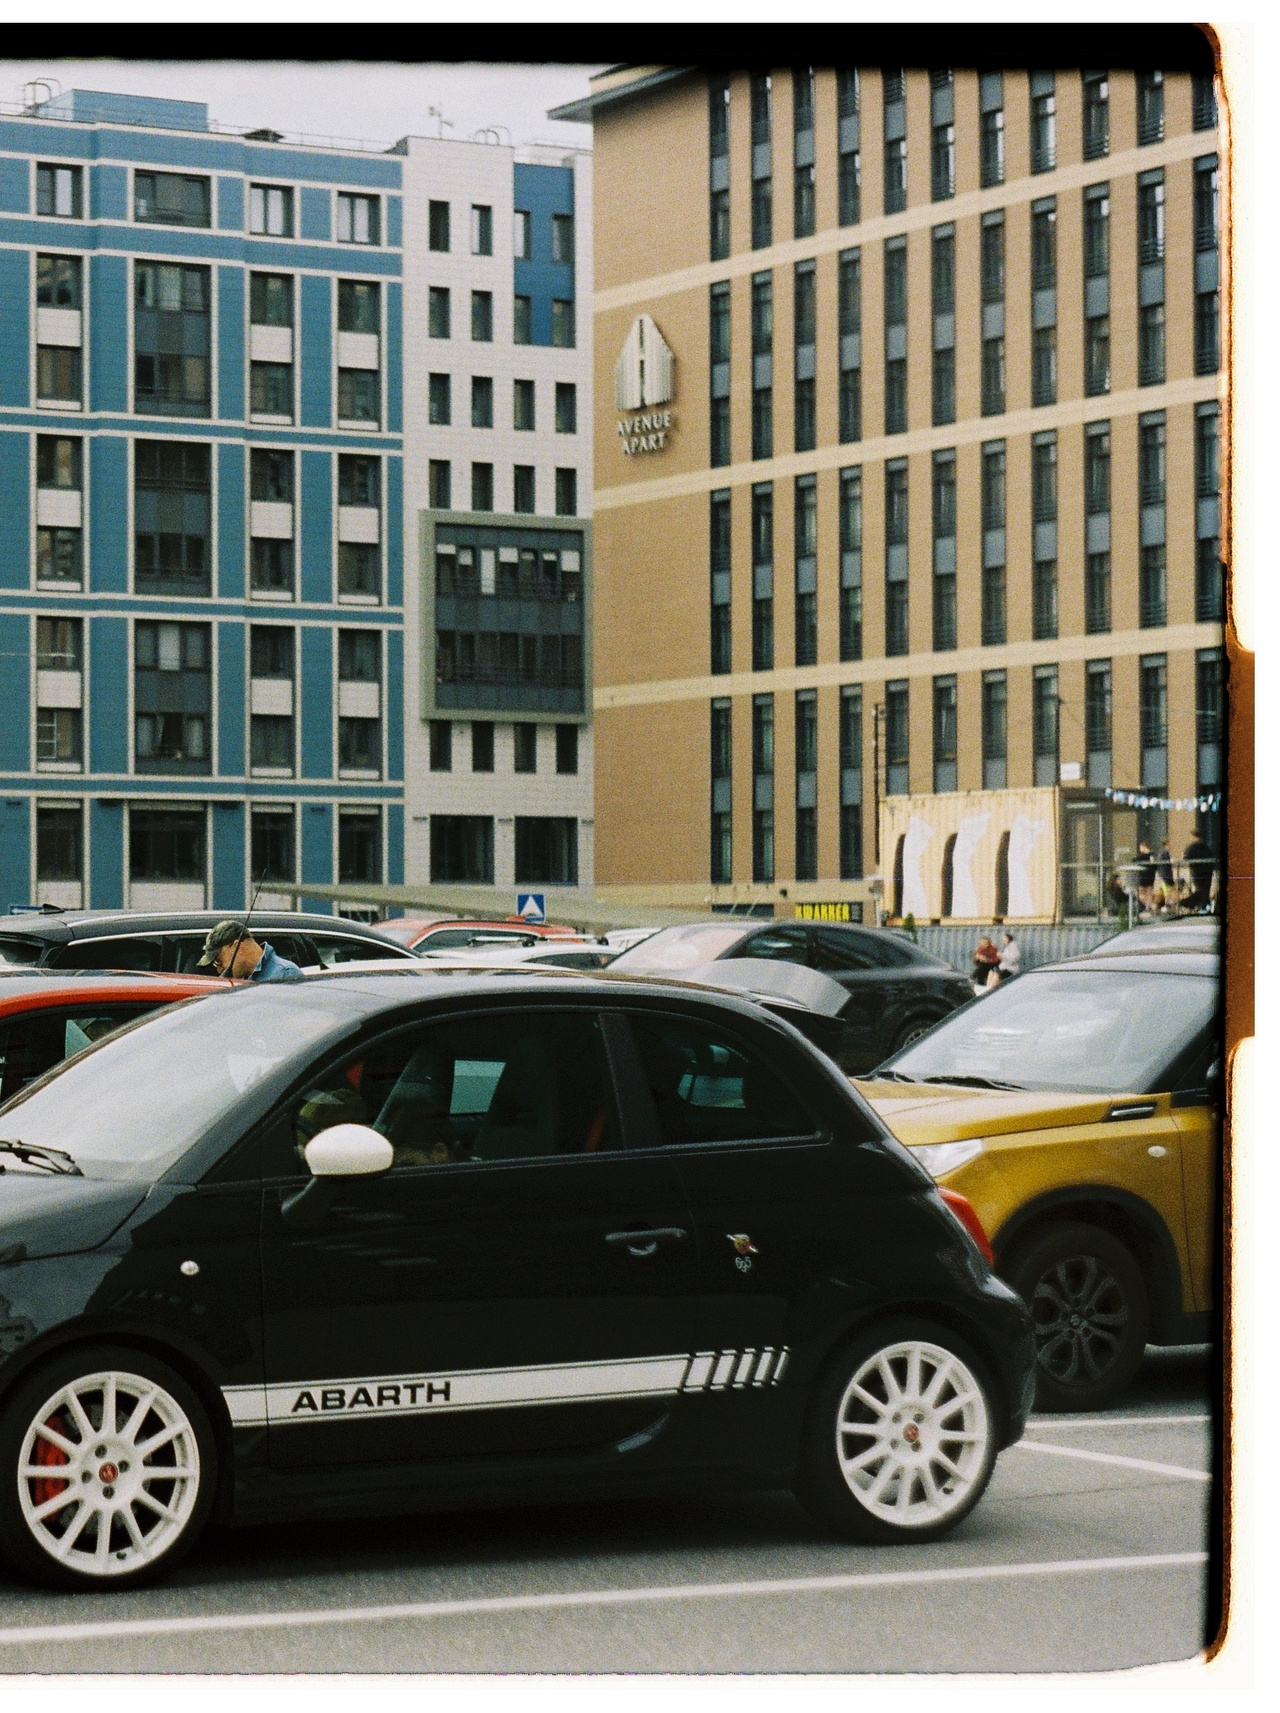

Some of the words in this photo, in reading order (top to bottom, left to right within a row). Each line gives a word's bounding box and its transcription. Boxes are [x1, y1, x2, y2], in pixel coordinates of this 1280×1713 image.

[618, 412, 671, 437] AVENUE
[623, 431, 667, 455] APART
[291, 1380, 451, 1413] ABARTH
